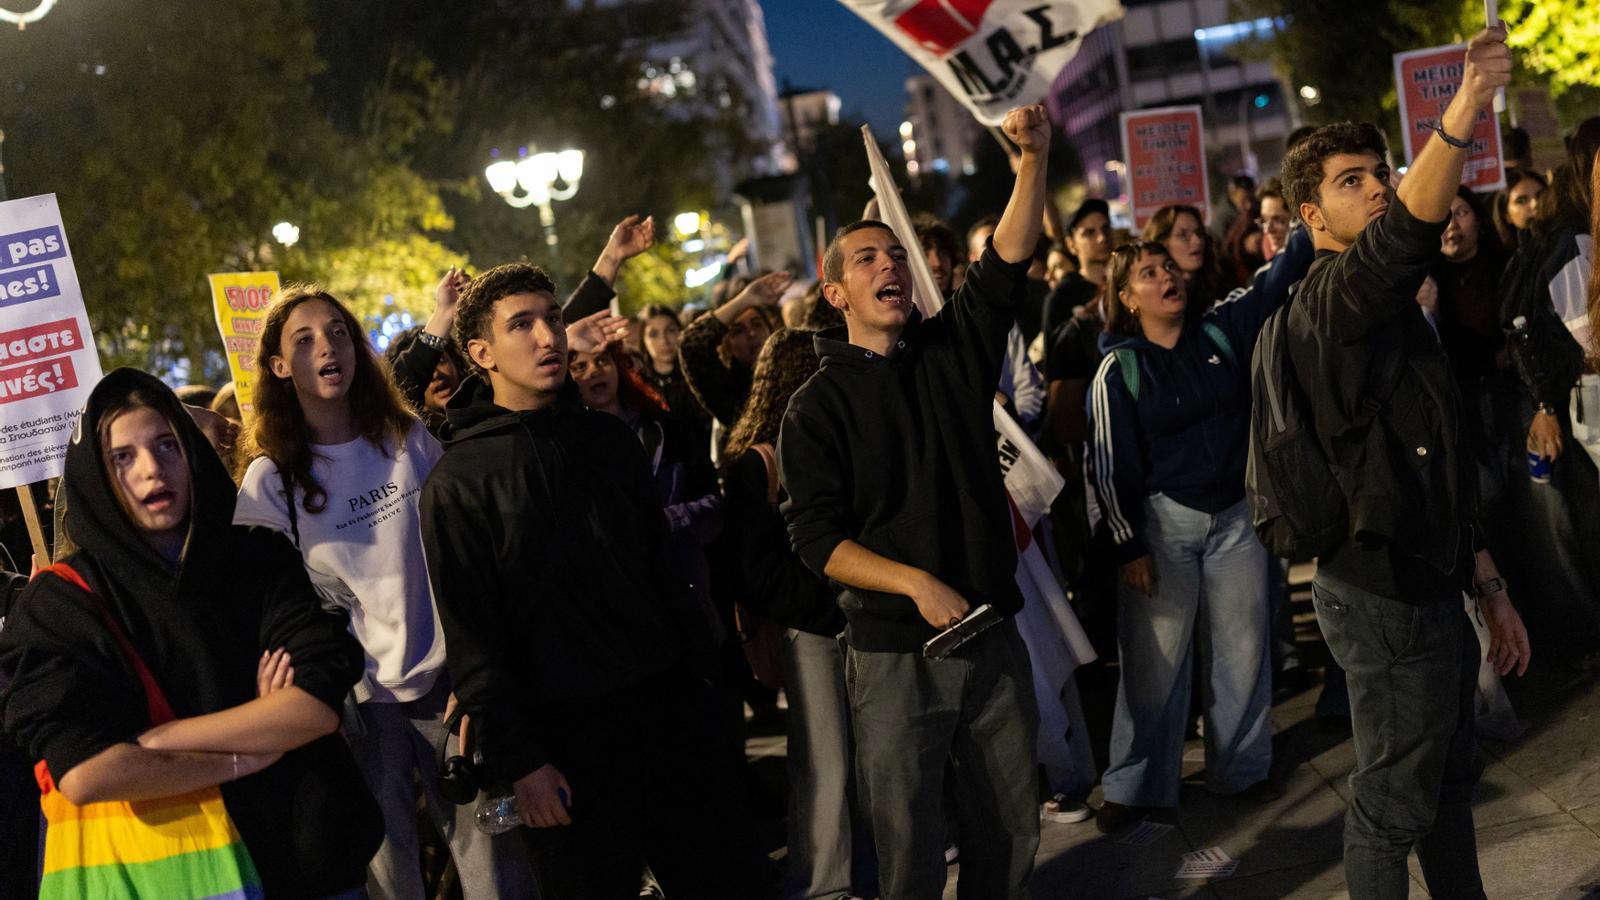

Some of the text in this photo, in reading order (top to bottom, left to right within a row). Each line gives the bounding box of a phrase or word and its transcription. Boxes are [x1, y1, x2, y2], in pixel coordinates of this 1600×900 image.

[8, 235, 60, 264] pas
[2, 425, 19, 434] des
[20, 414, 62, 429] étudiants
[348, 481, 398, 512] PARIS
[368, 507, 402, 529] ARCHIVE
